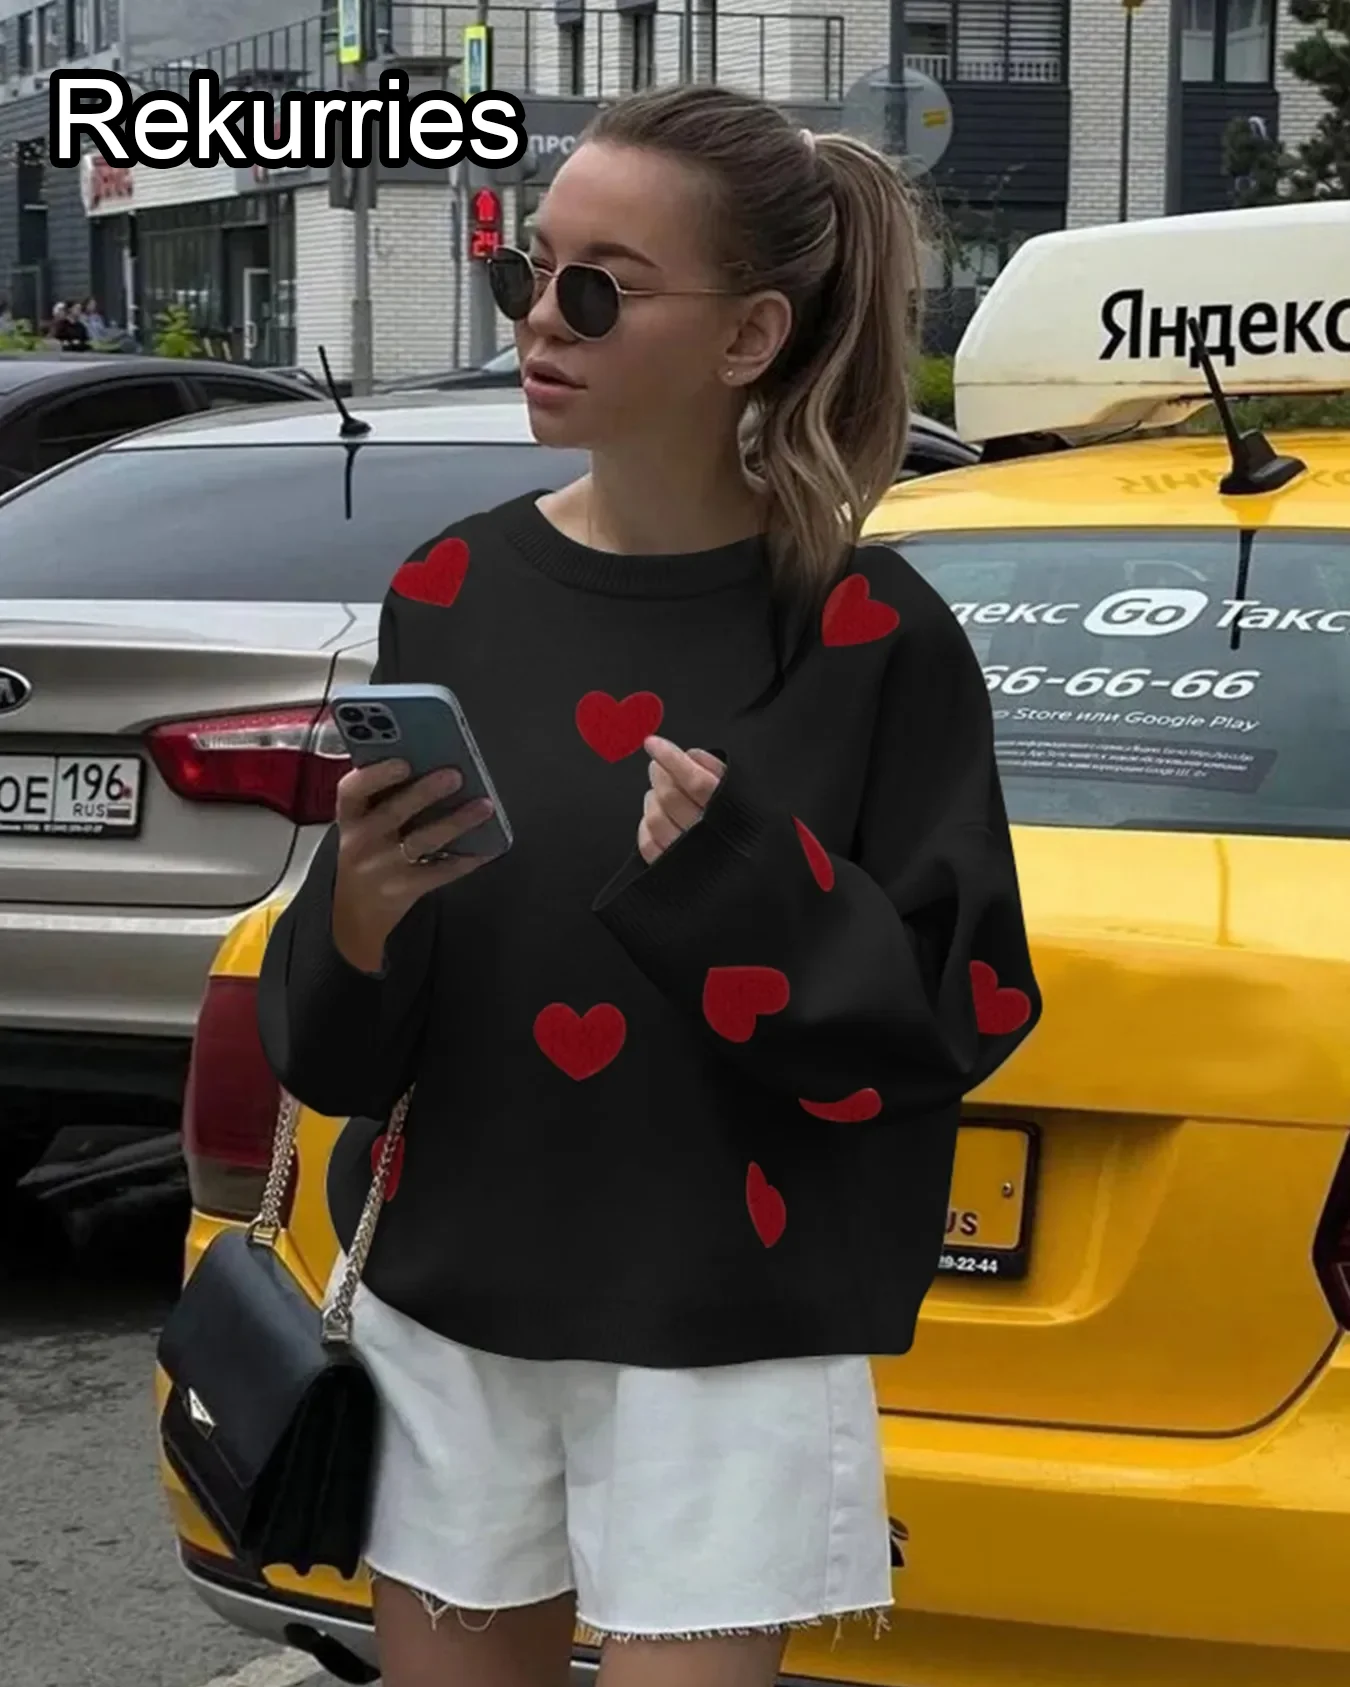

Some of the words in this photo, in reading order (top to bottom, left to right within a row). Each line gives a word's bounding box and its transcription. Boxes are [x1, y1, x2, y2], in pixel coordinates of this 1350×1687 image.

[1098, 289, 1350, 368] Яндекс
[1012, 707, 1073, 721] Store
[1075, 711, 1119, 723] или
[1123, 710, 1206, 728] Google
[1208, 715, 1261, 733] Play
[62, 763, 124, 801] 196
[73, 803, 105, 817] RUS
